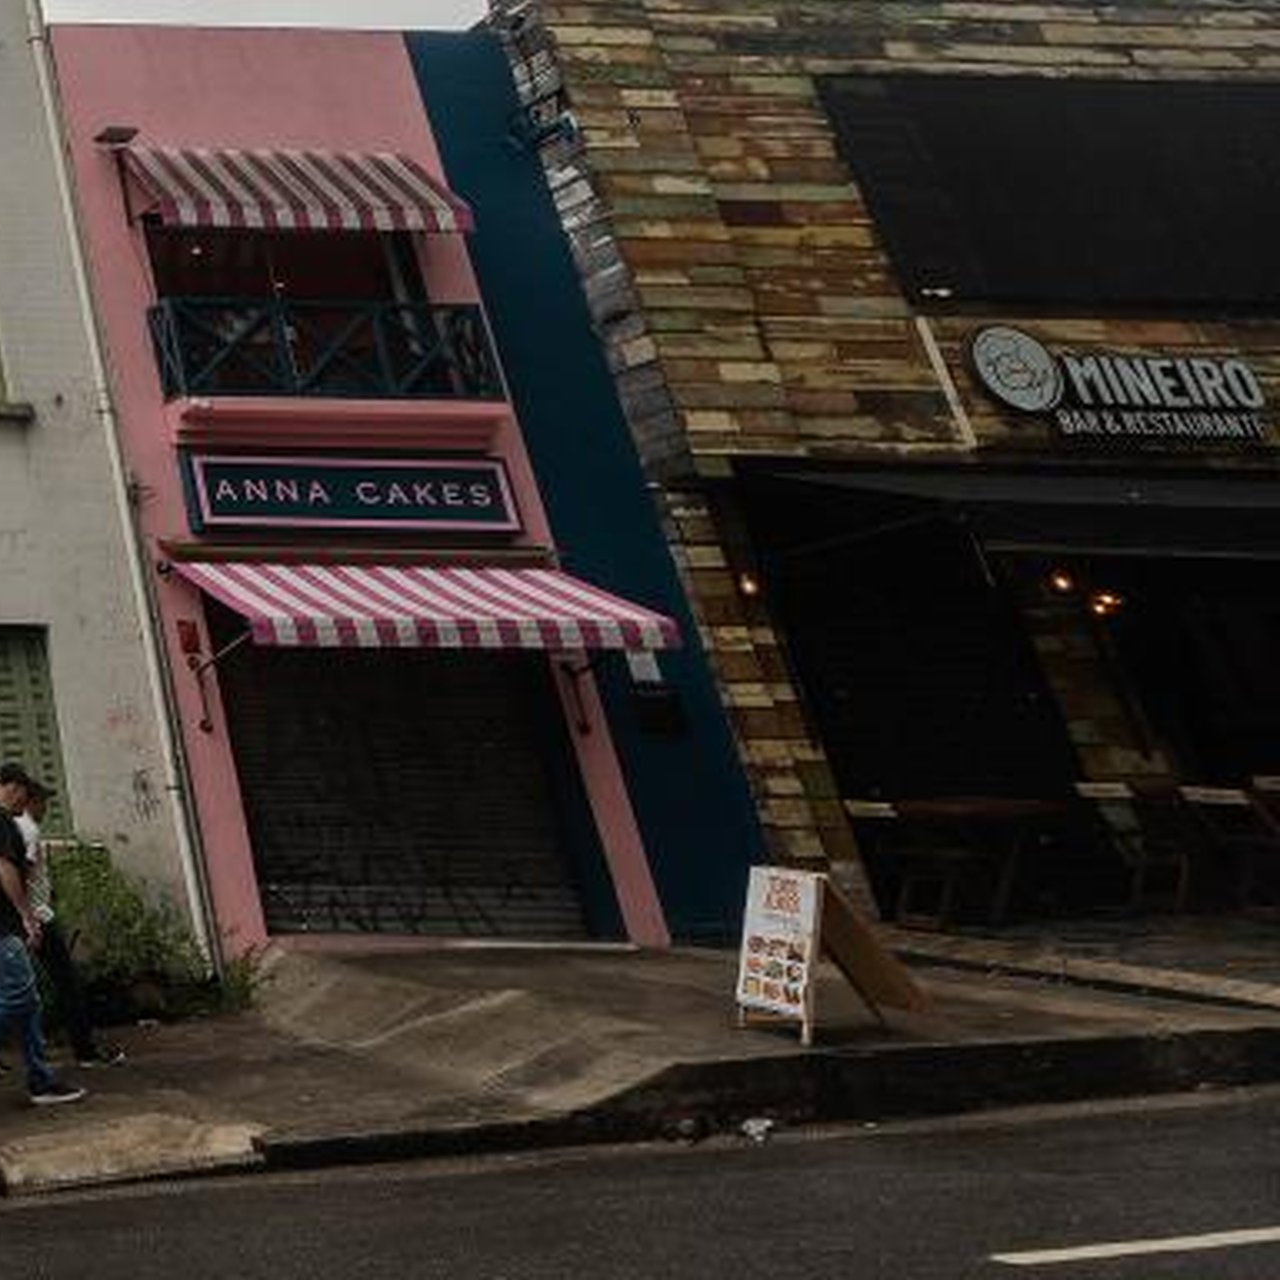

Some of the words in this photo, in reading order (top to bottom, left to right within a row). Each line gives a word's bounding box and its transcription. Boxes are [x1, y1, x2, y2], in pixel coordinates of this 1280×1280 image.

[1064, 356, 1265, 408] MINEIRO
[1055, 410, 1104, 434] BAR
[215, 478, 331, 504] ANNA
[354, 480, 492, 506] CAKES
